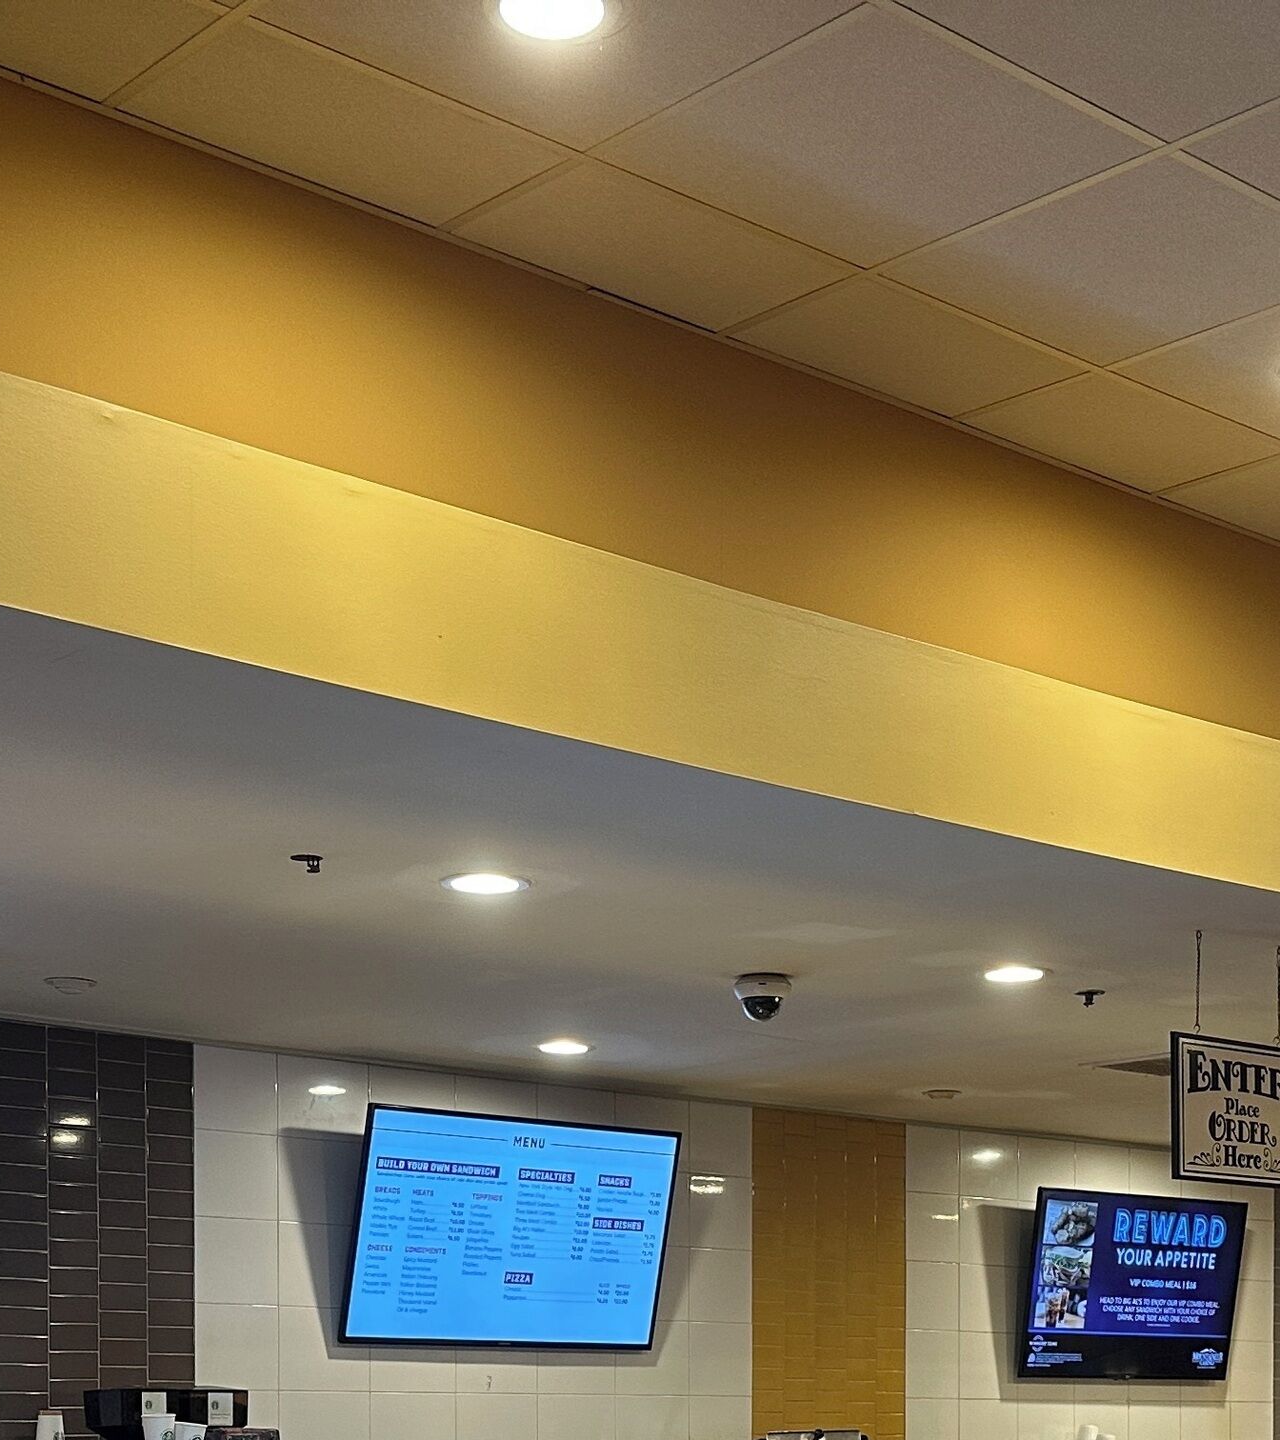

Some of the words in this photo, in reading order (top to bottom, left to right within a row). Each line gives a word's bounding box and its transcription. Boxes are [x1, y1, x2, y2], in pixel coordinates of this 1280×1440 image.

[1224, 1097, 1260, 1118] Place
[1208, 1111, 1277, 1147] ORDER
[513, 1136, 545, 1149] MENU
[1223, 1145, 1262, 1169] Here
[377, 1159, 405, 1169] BUILD
[407, 1161, 429, 1171] YOUR
[430, 1163, 450, 1173] OWN
[451, 1165, 496, 1176] SANDWICH
[520, 1170, 573, 1182] SPECIALTIES
[600, 1176, 631, 1187] SNACKS
[594, 1219, 613, 1229] SIDE
[613, 1221, 642, 1230] DISHES
[1113, 1208, 1227, 1248] REWARD
[1116, 1247, 1153, 1266] YOUR
[1154, 1250, 1217, 1270] APPETITE
[505, 1273, 531, 1283] PIZZA
[1129, 1278, 1141, 1287] VIP
